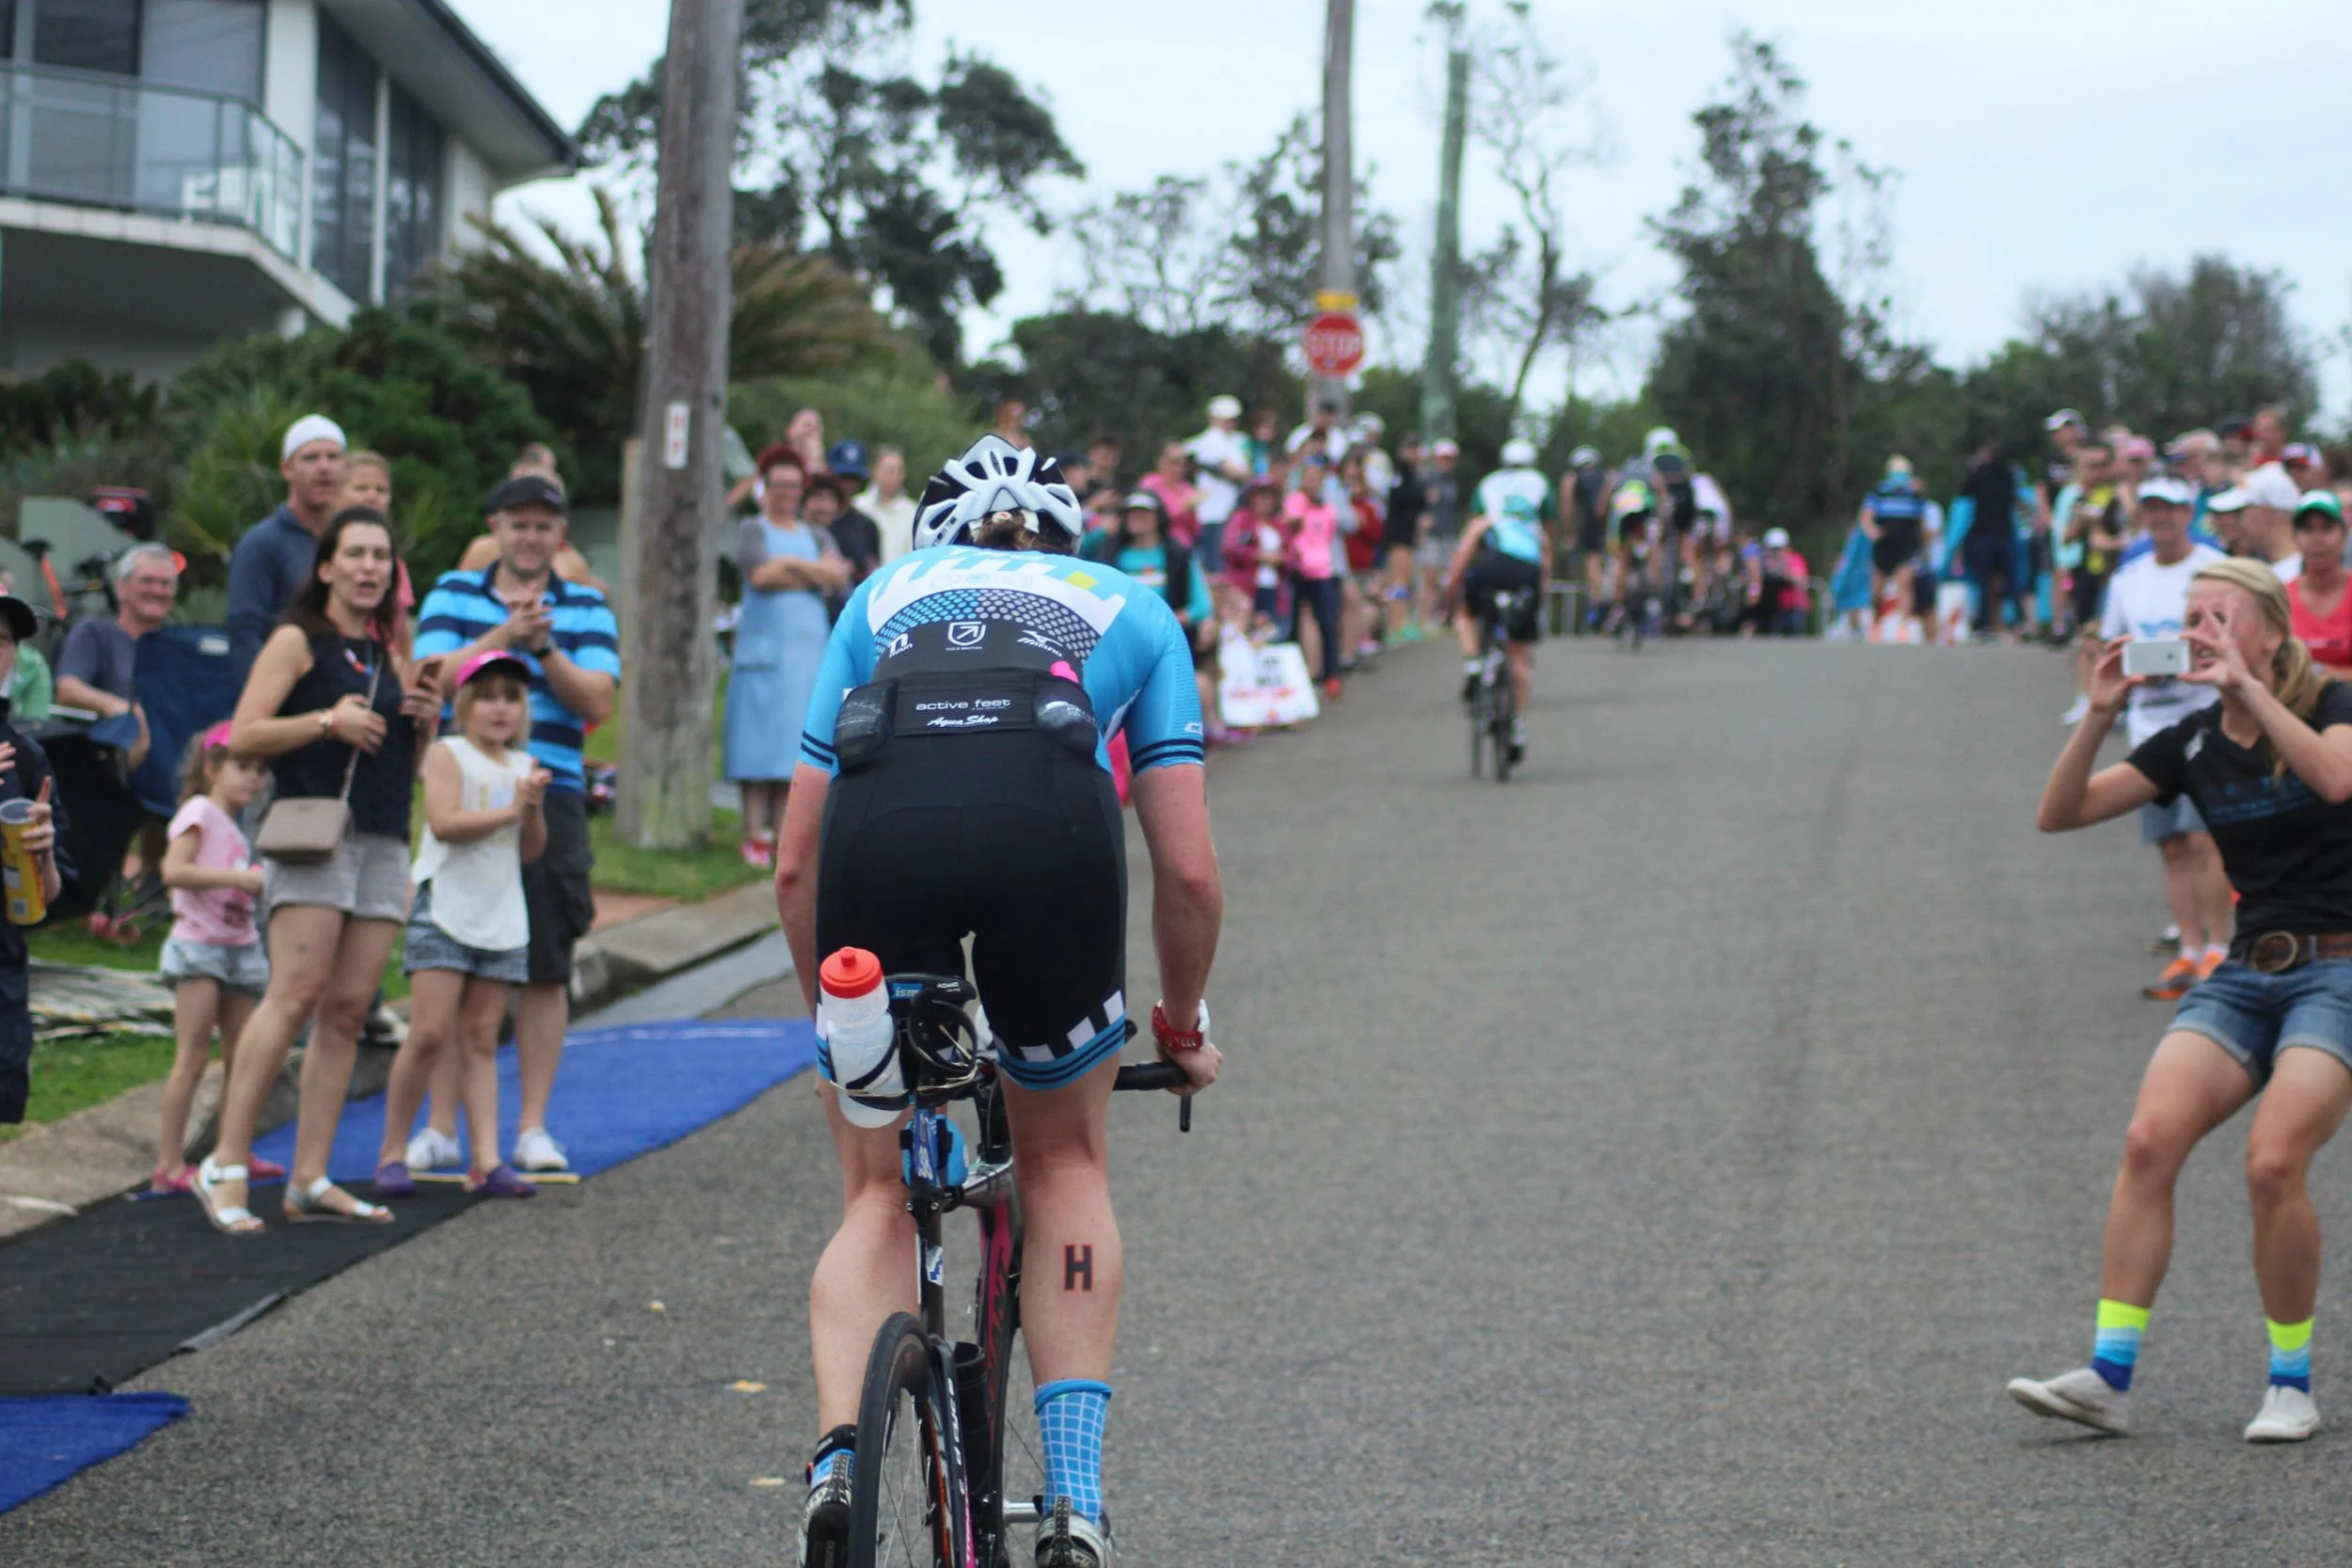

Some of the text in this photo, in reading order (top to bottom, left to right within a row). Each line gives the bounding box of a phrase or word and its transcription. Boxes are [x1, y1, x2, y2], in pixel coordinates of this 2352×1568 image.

[916, 701, 968, 711] active
[975, 699, 1011, 707] feet
[926, 715, 998, 727] Aqua Shop
[1063, 1244, 1093, 1291] H
